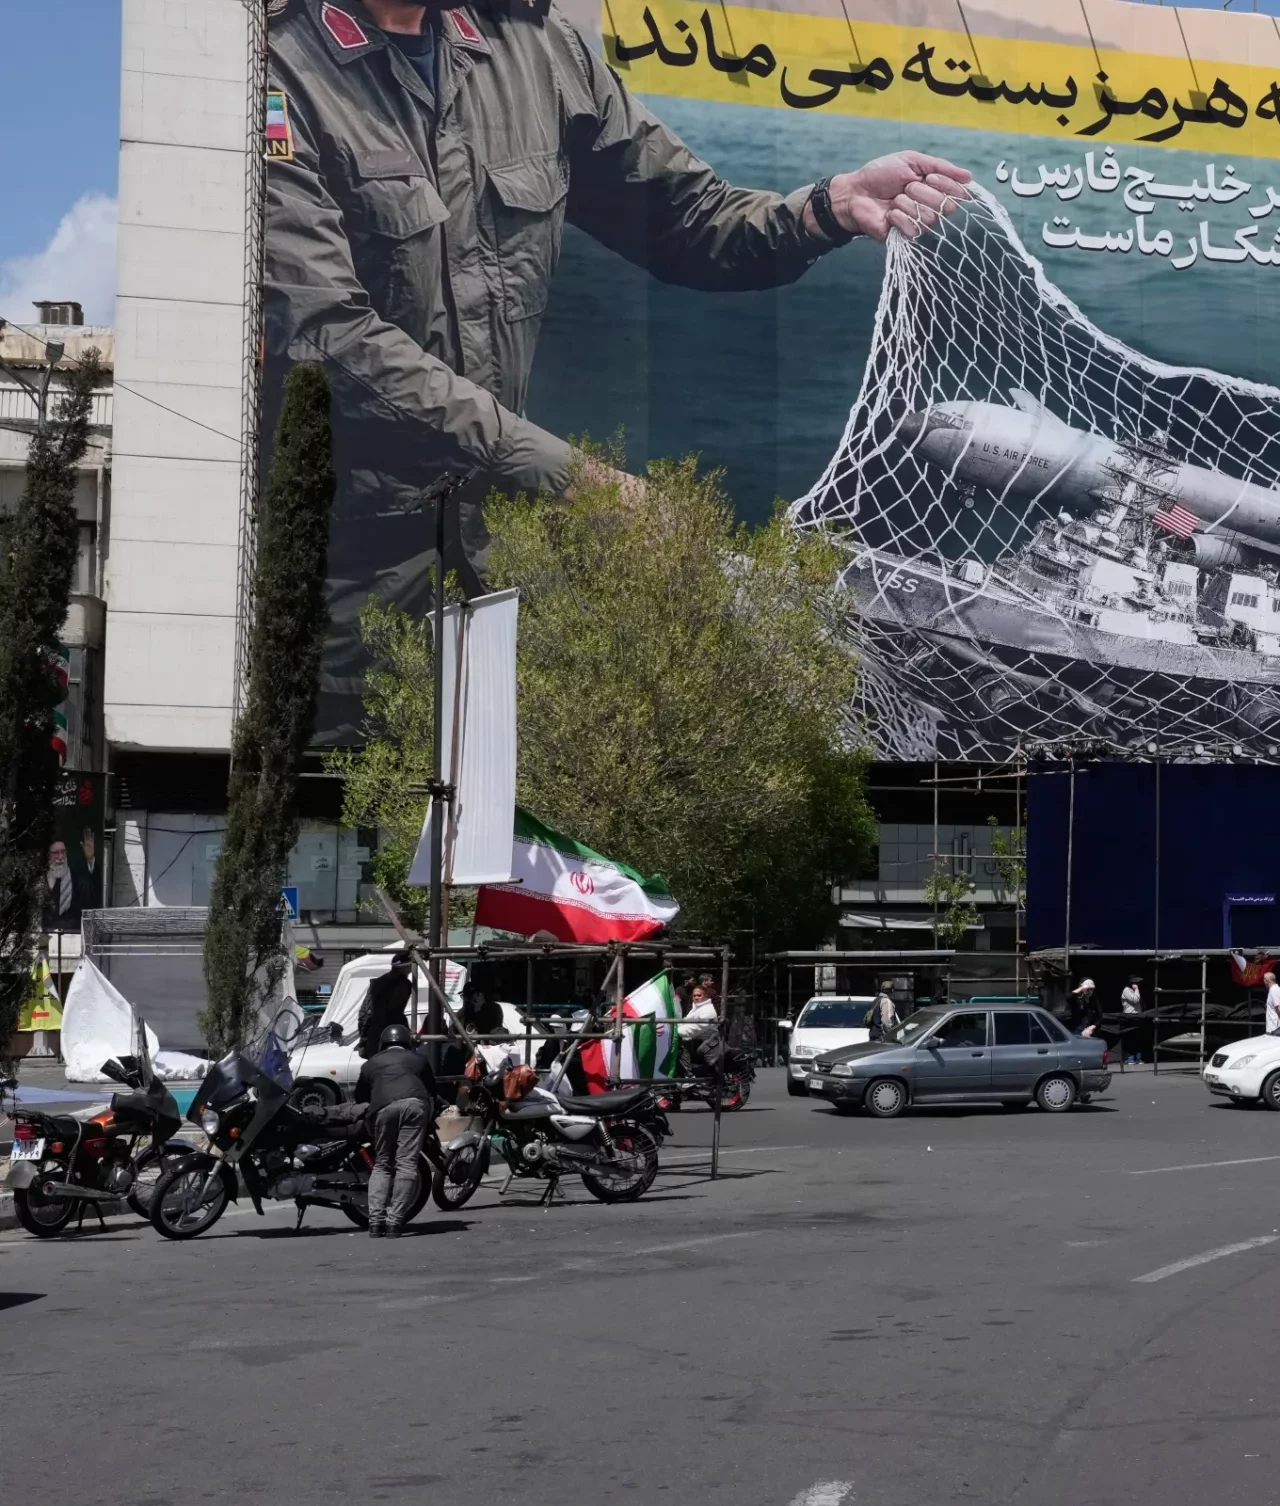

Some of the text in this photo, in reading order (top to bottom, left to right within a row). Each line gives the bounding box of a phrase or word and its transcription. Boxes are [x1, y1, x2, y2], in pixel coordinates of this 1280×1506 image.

[901, 41, 1078, 127] بسته
[1074, 70, 1248, 142] هرمز
[1042, 214, 1174, 256] ماست
[983, 442, 1000, 457] U.S.
[1003, 448, 1019, 461] AIR
[876, 568, 919, 593] USS
